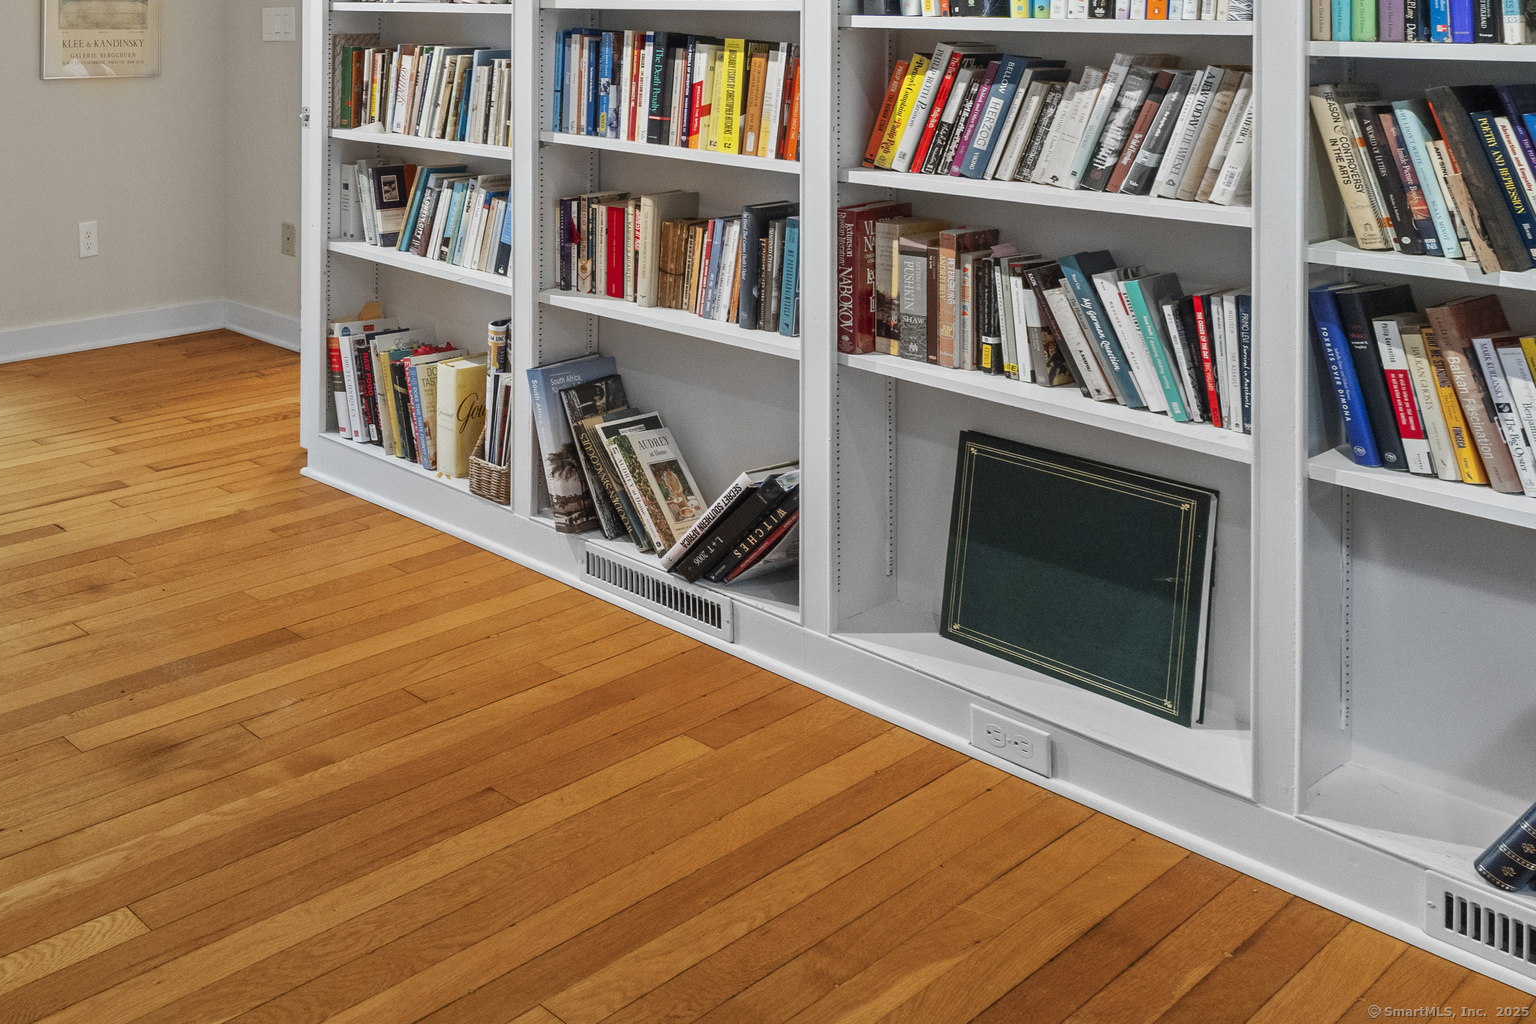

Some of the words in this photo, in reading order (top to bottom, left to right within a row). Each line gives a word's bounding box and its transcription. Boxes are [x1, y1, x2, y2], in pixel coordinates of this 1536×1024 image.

[62, 40, 84, 48] KLEE
[94, 39, 144, 47] KANDINSKY
[655, 48, 665, 63] The
[929, 49, 944, 75] PHILIP
[653, 64, 663, 86] Death
[998, 61, 1015, 94] BELLOW
[1207, 71, 1216, 81] A
[920, 76, 933, 99] ROTH
[1197, 80, 1213, 100] JEW
[650, 88, 661, 112] Penalty
[1323, 91, 1342, 123] REASON
[976, 101, 1001, 147] HERZOG
[1186, 98, 1206, 129] TODAY
[1182, 127, 1196, 147] ELIE
[1329, 138, 1338, 147] IN
[1333, 125, 1348, 137] &
[1365, 125, 1378, 146] WORLD
[1477, 117, 1498, 148] POETRY
[1500, 124, 1518, 156] Abstraction
[968, 152, 980, 171] VIKING
[1169, 145, 1190, 177] WIESEL
[1331, 147, 1343, 163] THE
[1372, 146, 1381, 154] OF
[1491, 150, 1507, 167] AND
[1514, 156, 1524, 167] and
[1336, 164, 1352, 185] ARTS
[1338, 136, 1365, 194] CONTROVERSY
[1374, 154, 1388, 177] LETTERS
[1498, 167, 1526, 215] REPRESSION
[1517, 168, 1533, 192] Empathy
[420, 196, 430, 222] LONELY
[416, 223, 424, 239] CITY
[904, 260, 914, 312] PUSHKIN
[947, 257, 955, 305] PETERSBURG
[838, 266, 853, 332] NABOKOV
[902, 316, 924, 324] SHAW
[1197, 319, 1205, 335] ORDER
[1080, 297, 1093, 309] My
[1088, 310, 1106, 340] German
[1100, 340, 1122, 372] Question
[363, 352, 371, 370] RAW
[1479, 343, 1492, 361] MARK
[365, 373, 374, 396] FOOD
[1321, 327, 1334, 362] FOXBATS
[1331, 365, 1342, 386] OVER
[1337, 389, 1351, 422] DIMONA
[1484, 362, 1505, 400] KURLANSKY
[345, 370, 356, 418] TECHNIQUES
[1447, 356, 1470, 394] Balkan
[1462, 397, 1495, 460] Fascination
[1503, 416, 1515, 432] The
[419, 434, 427, 455] FUNNY?
[637, 436, 671, 451] AUDREY
[1508, 433, 1521, 446] Big
[580, 432, 614, 492] SYNAGOGUES
[1514, 447, 1528, 473] Oyster
[617, 458, 634, 491] AUDREY
[634, 498, 647, 516] Home
[722, 483, 742, 507] SECRET
[697, 502, 724, 533] SOUTHERN
[679, 526, 700, 548] AFRICA
[733, 508, 787, 559] WITCHES
